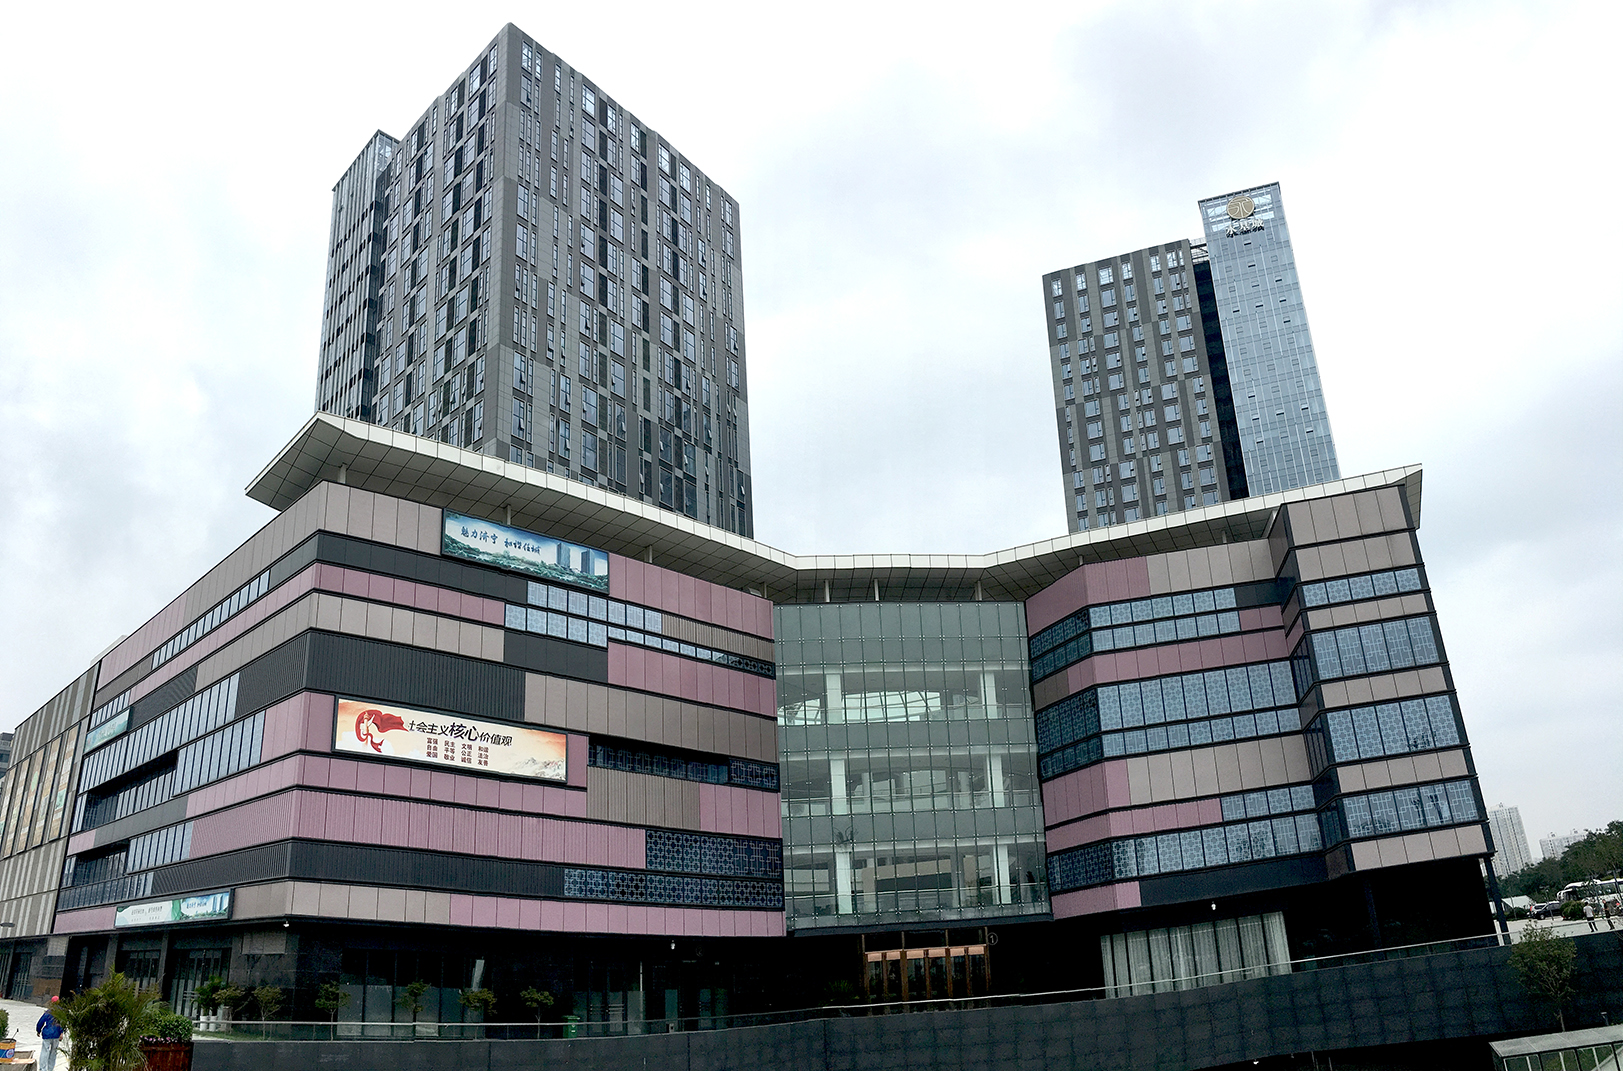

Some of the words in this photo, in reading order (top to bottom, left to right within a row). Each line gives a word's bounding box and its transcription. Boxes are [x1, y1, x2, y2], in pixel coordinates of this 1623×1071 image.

[461, 526, 498, 544] 魅力济宁
[426, 737, 438, 745] 富强
[444, 740, 455, 748] 民主
[426, 751, 438, 759] 爱国
